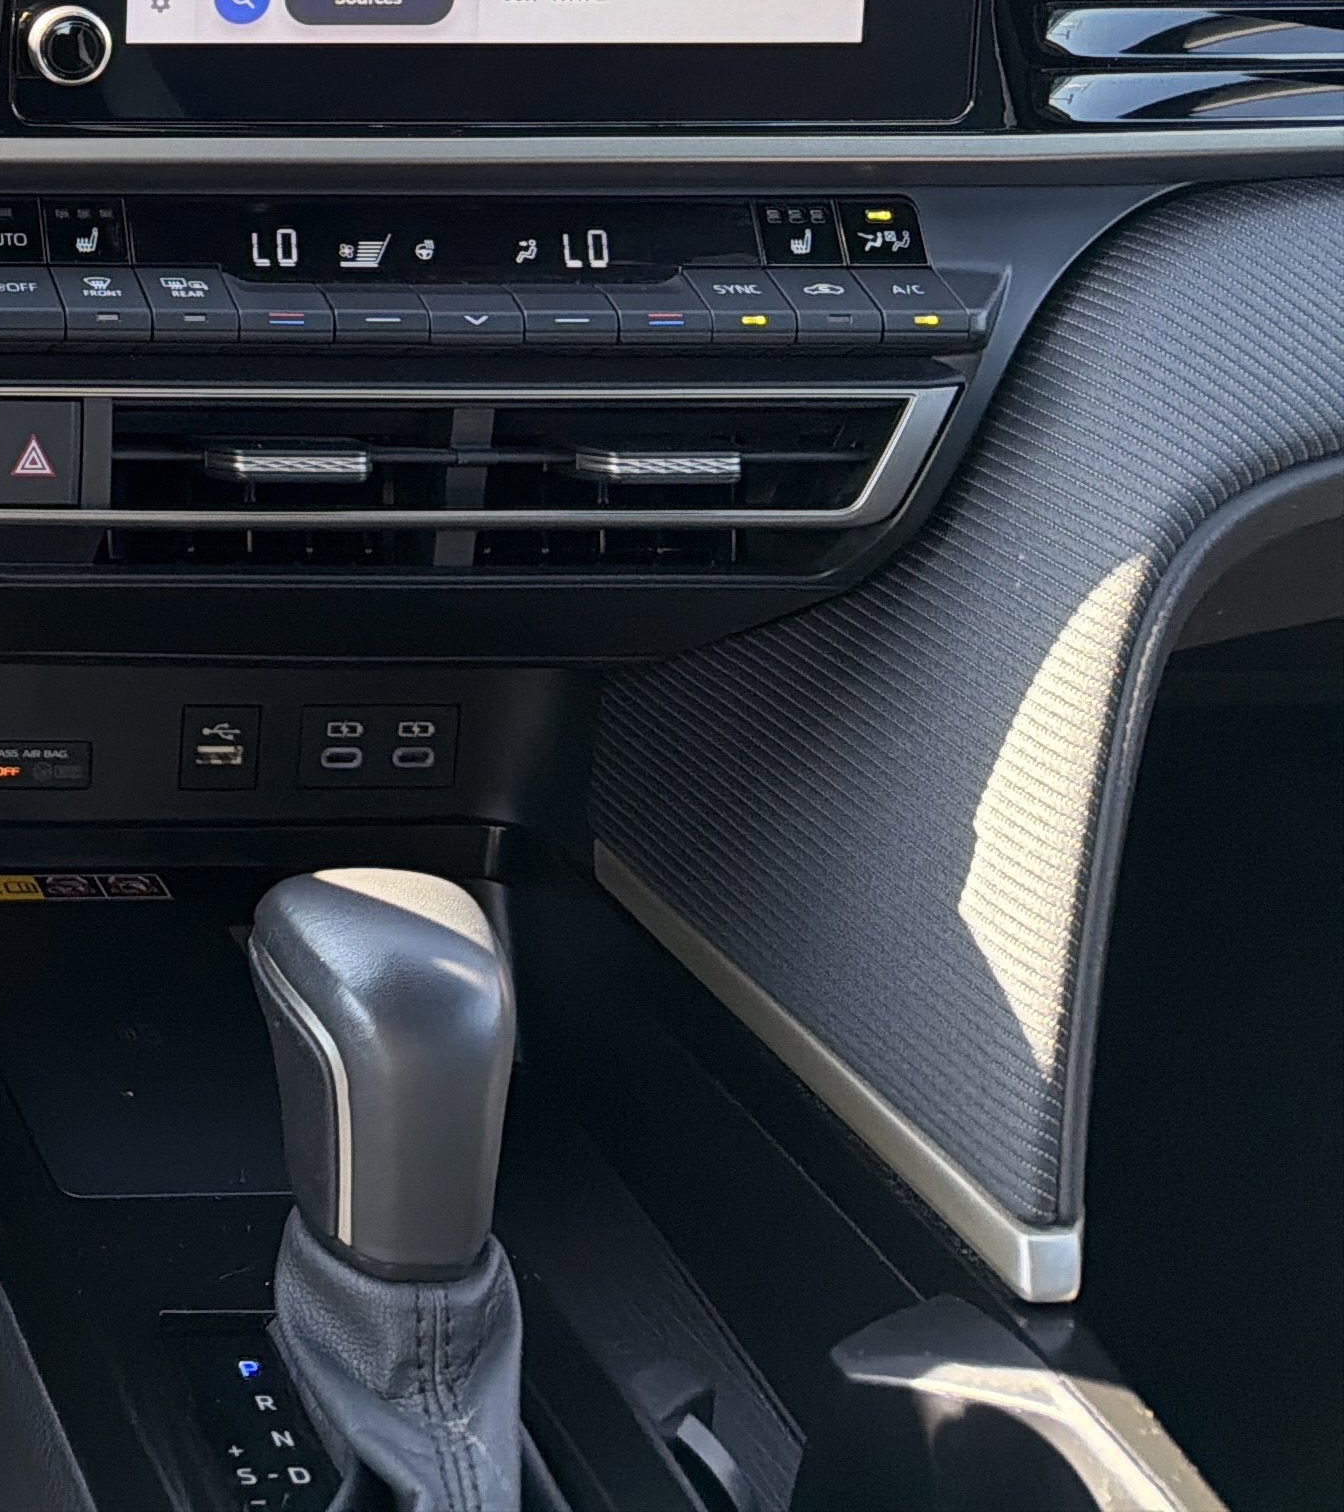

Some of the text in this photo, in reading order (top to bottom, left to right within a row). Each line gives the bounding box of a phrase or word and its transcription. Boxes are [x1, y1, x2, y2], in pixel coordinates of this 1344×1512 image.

[251, 228, 298, 267] LO
[562, 229, 609, 268] LO
[5, 282, 37, 292] OFF
[82, 289, 123, 298] FRONT
[171, 290, 206, 298] REAR
[712, 284, 763, 296] SYNC
[892, 284, 926, 296] A/C
[22, 749, 41, 758] AIR
[43, 750, 68, 759] BAG
[238, 1359, 261, 1378] P
[254, 1394, 278, 1411] R
[270, 1430, 295, 1447] N
[236, 1466, 311, 1485] S D
